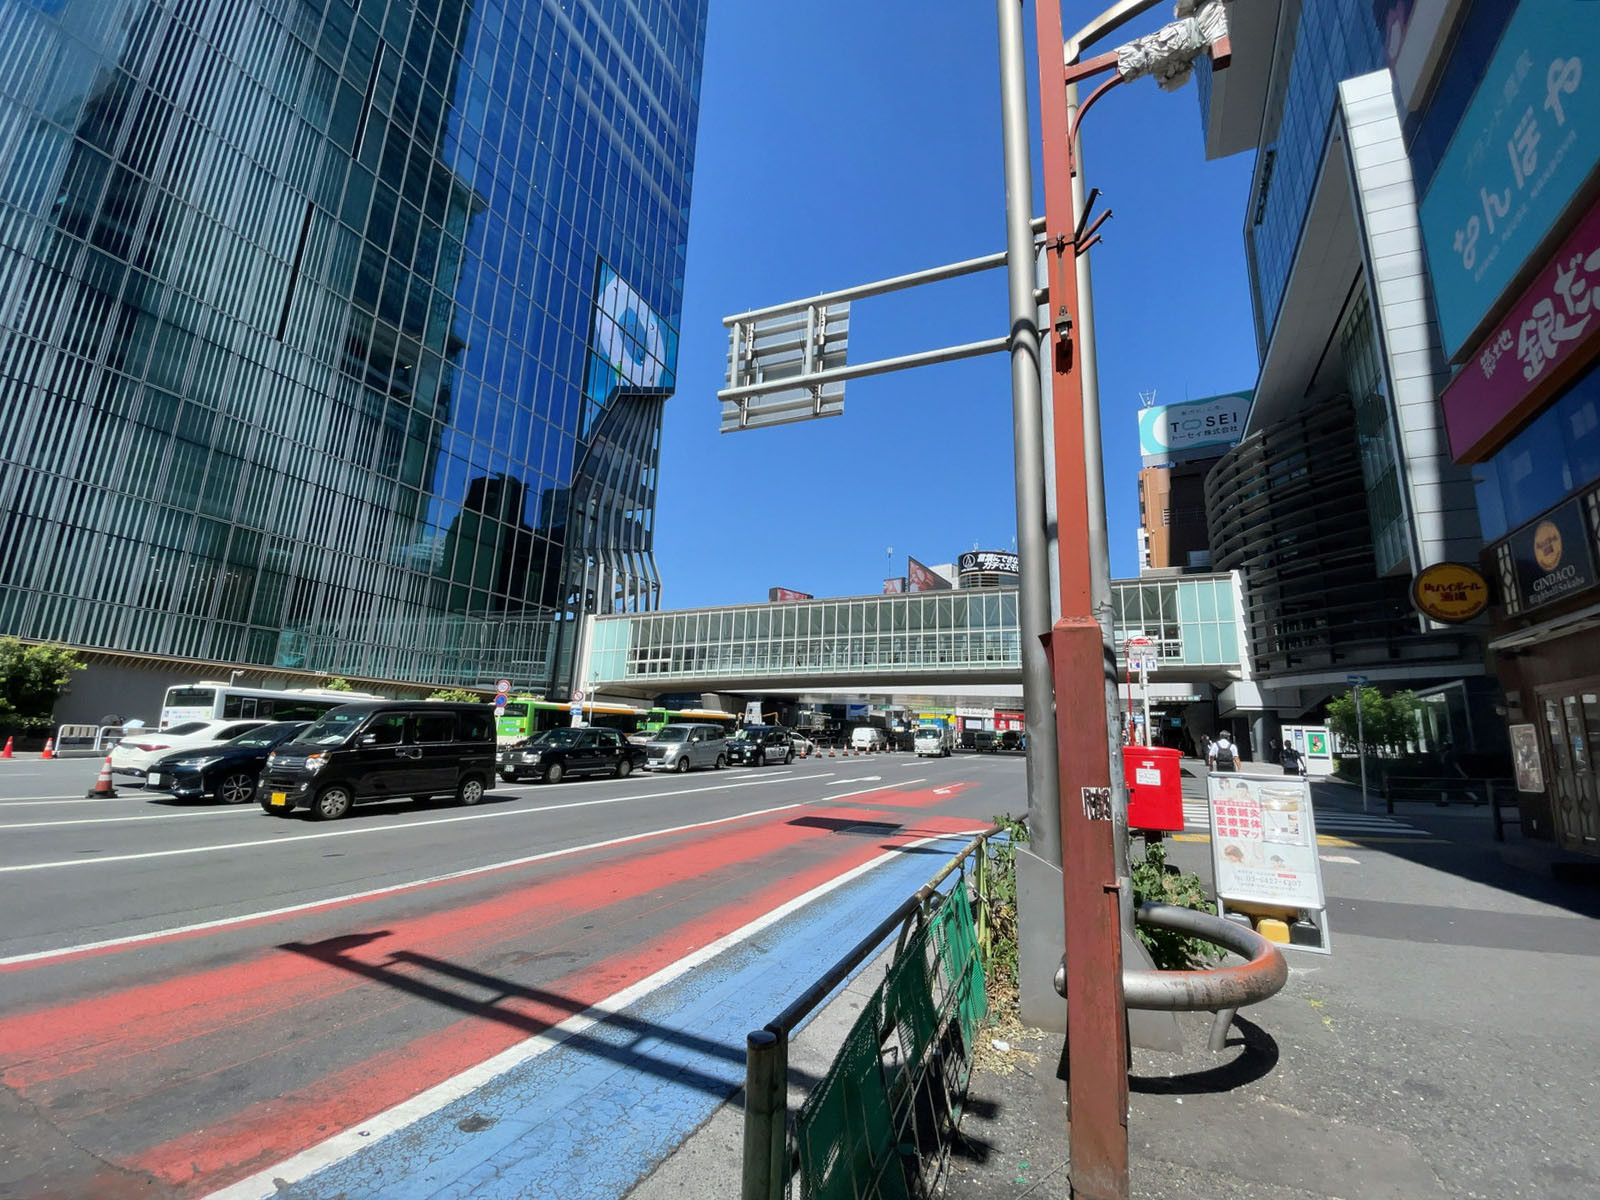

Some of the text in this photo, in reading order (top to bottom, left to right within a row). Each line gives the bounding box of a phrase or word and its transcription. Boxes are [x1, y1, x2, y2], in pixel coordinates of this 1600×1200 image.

[1453, 56, 1583, 270] なんぼや
[1480, 329, 1514, 379] 築地
[1171, 425, 1239, 441] トーセイ株式会社
[1533, 564, 1576, 592] GINDACO
[1216, 816, 1262, 829] 医療整体
